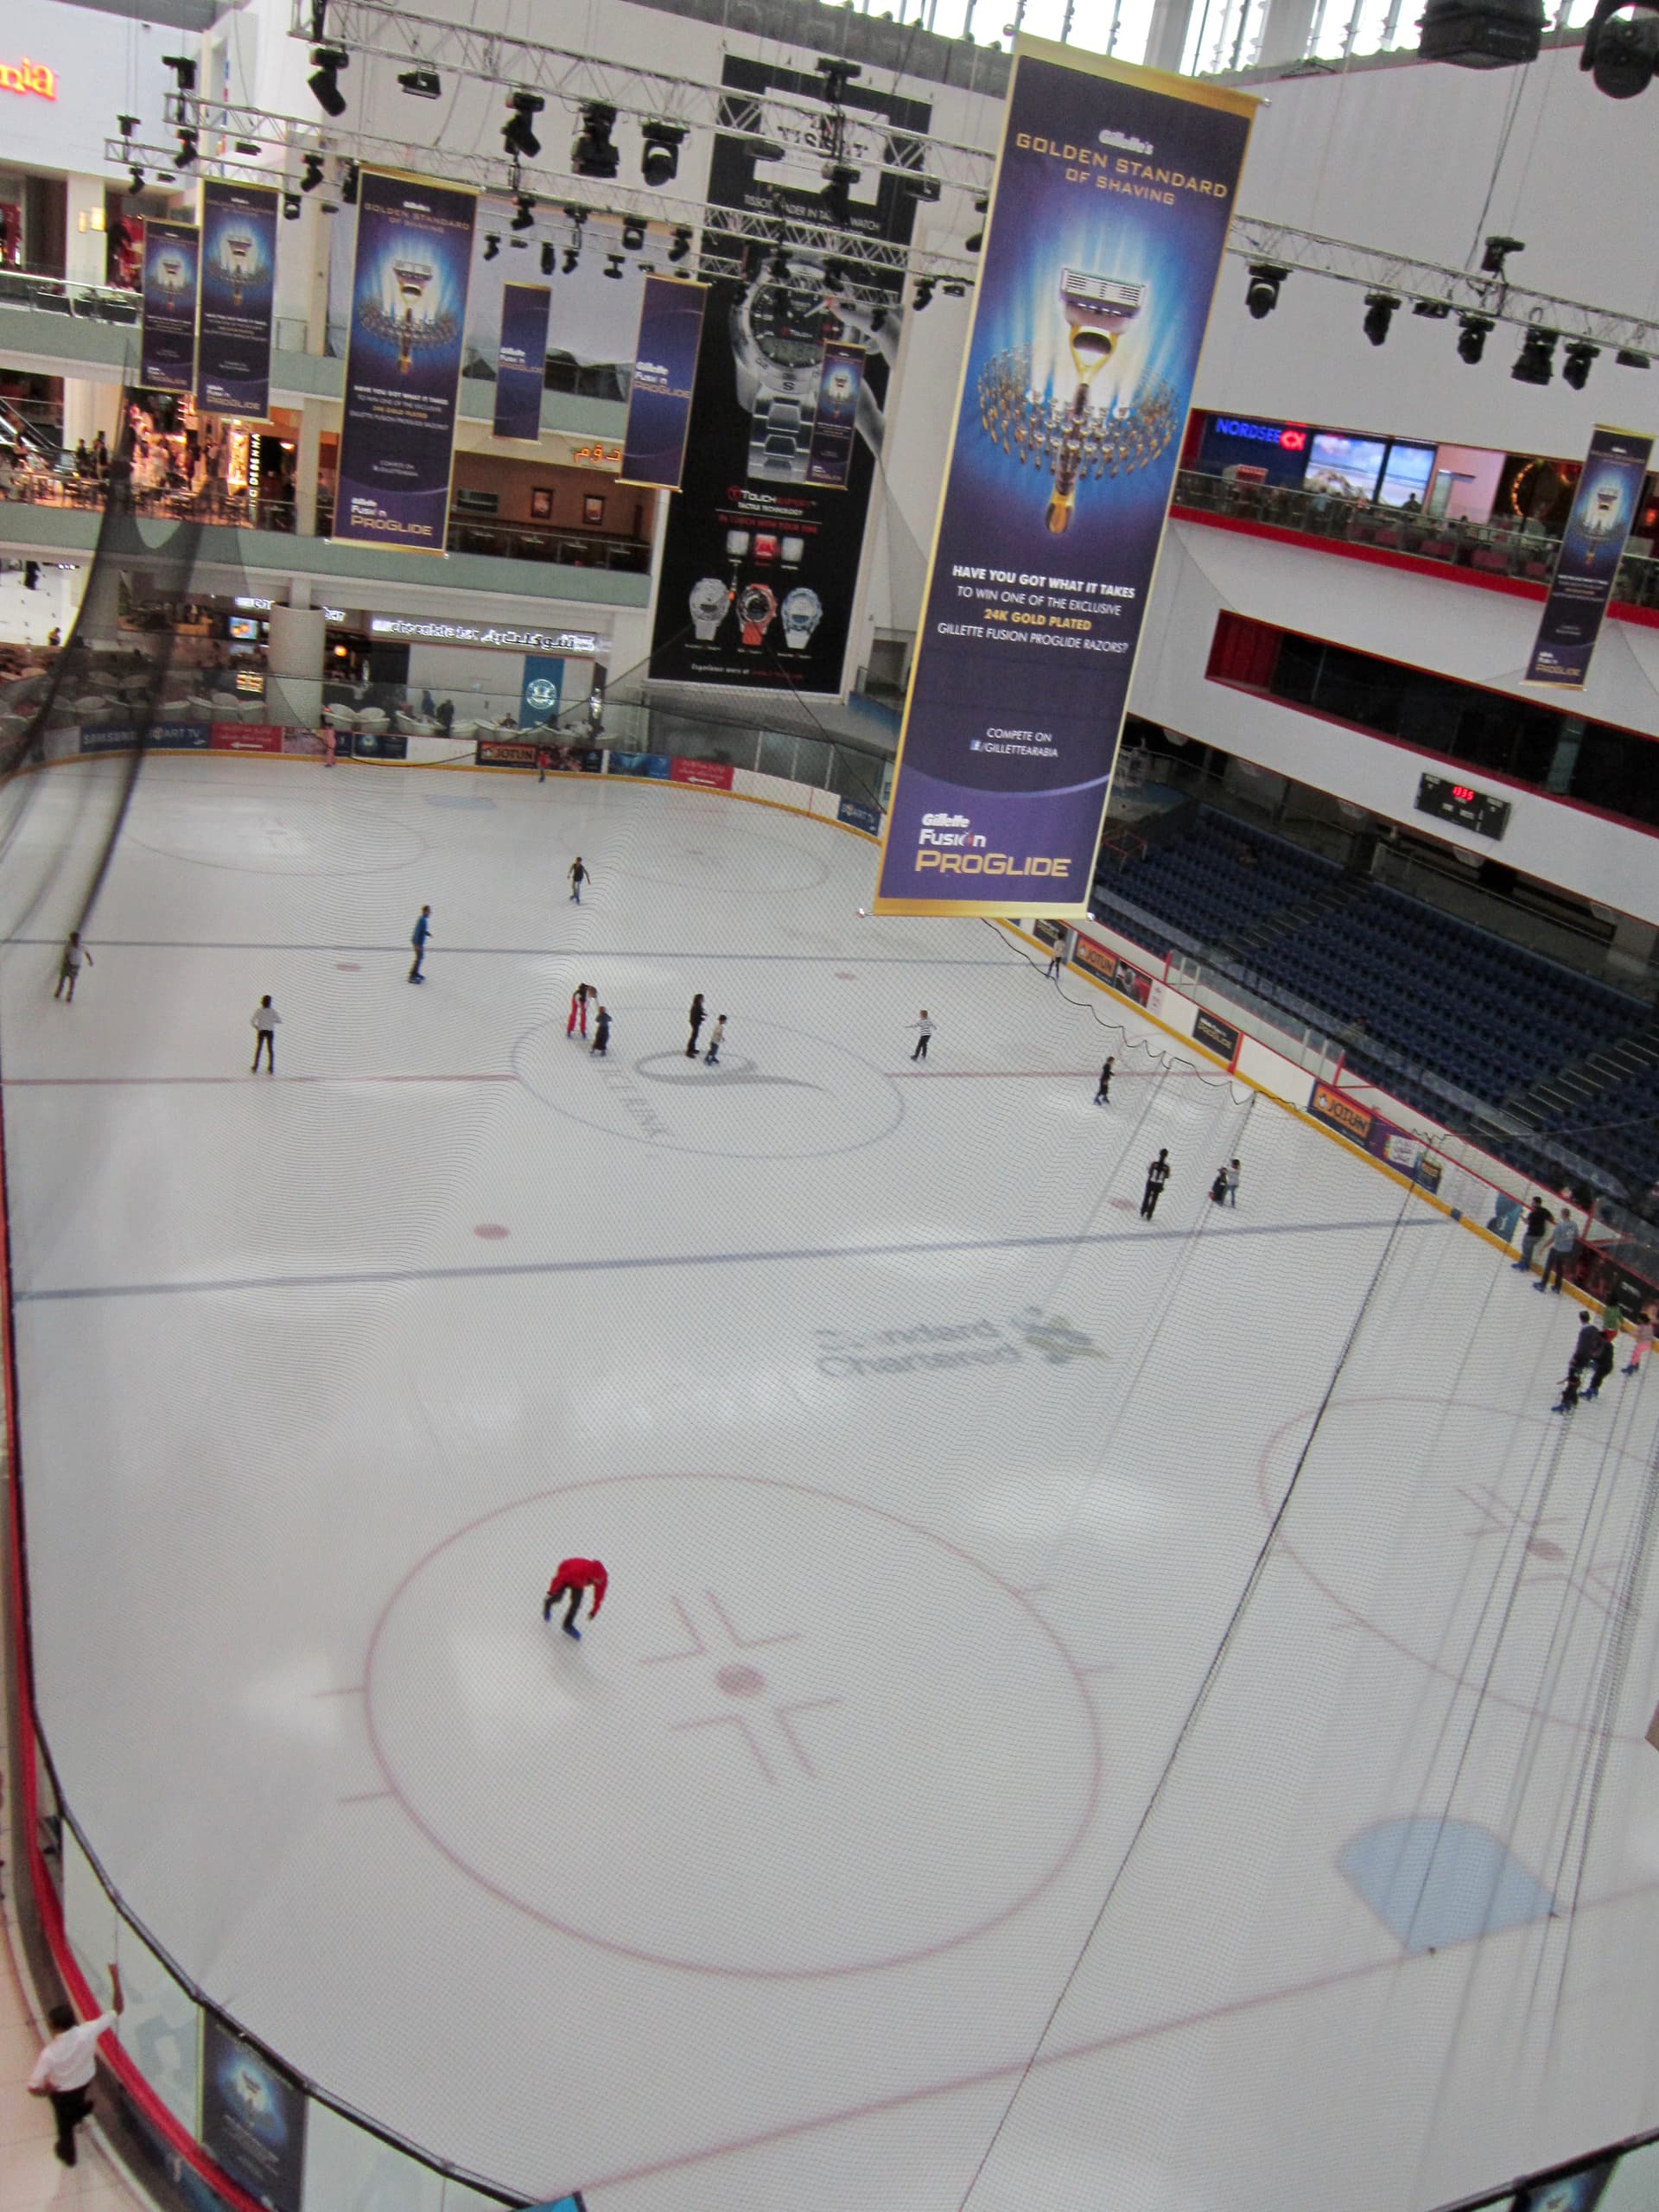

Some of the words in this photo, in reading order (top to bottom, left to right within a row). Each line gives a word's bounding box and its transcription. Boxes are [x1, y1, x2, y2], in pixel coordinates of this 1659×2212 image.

[1016, 132, 1108, 168] GOLDEN
[1115, 158, 1228, 198] STANDARD
[1065, 168, 1090, 183] OF
[1096, 175, 1175, 206] SHAVING
[1215, 418, 1282, 443] NORDSEE
[351, 515, 433, 536] PROGLIDE
[952, 565, 987, 580] HAVE
[989, 569, 1016, 583] YOU
[1019, 574, 1046, 587] GOT
[1049, 577, 1084, 592] WHAT
[1085, 582, 1096, 594] IT
[1100, 584, 1135, 598] TAKES
[957, 586, 973, 598] TO
[976, 588, 998, 601] WIN
[1001, 591, 1026, 605] ONE
[1028, 594, 1045, 607] OF
[1047, 597, 1065, 609] THE
[1069, 600, 1122, 616] EXCLUSIVE
[984, 608, 1007, 621] 24K
[1011, 612, 1046, 626] GOLD
[1049, 616, 1091, 631] PLATED
[938, 622, 983, 638] GILLETTE
[986, 628, 1028, 643] FUSION
[1030, 632, 1082, 649] PROGLIDE
[1083, 639, 1129, 653] RAZORS?
[987, 728, 1033, 741] COMPETE
[1035, 732, 1052, 742] ON
[921, 813, 970, 828] Gillette
[915, 849, 1071, 877] PROGLIDE
[1328, 1101, 1367, 1133] JOTUN
